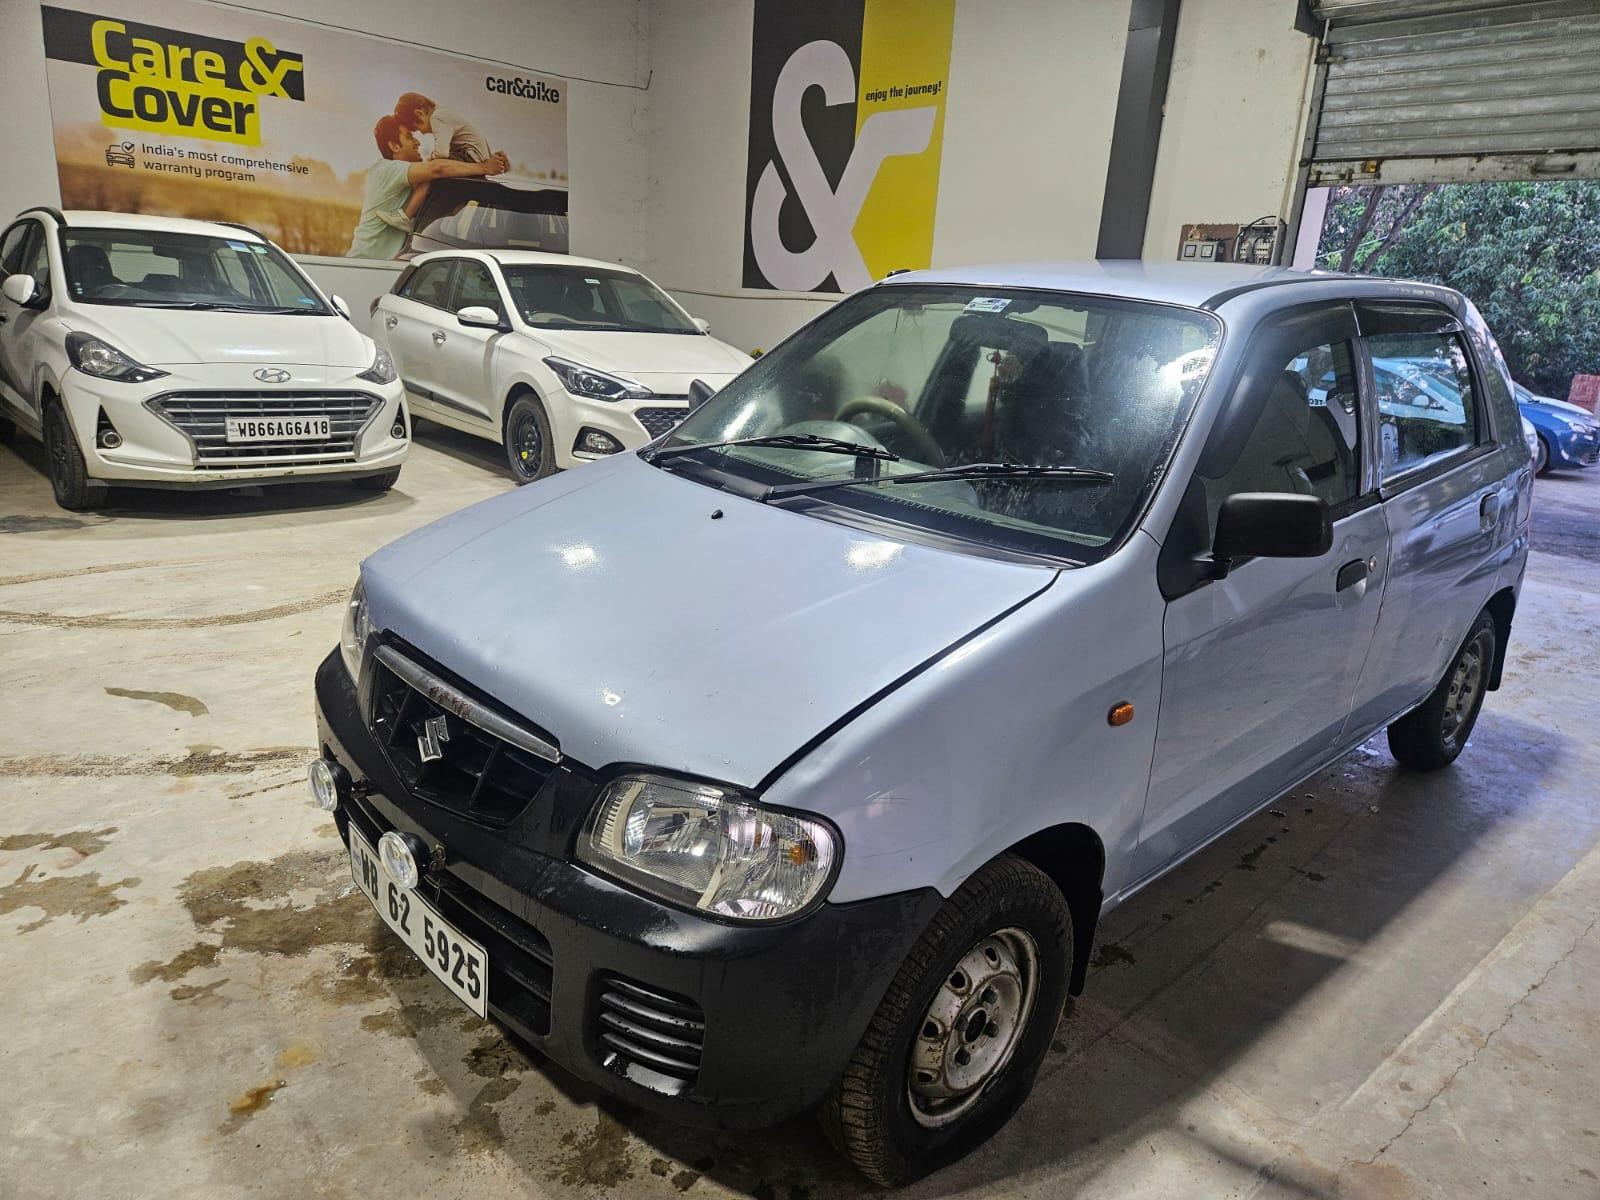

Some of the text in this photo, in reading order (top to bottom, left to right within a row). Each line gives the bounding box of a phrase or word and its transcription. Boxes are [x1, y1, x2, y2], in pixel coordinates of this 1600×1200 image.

[91, 19, 303, 99] Care &
[97, 69, 255, 135] Cover
[486, 77, 559, 103] car&bike
[865, 81, 942, 102] enjoy the journey!
[142, 143, 309, 175] India's most comprehensive
[143, 160, 256, 182] warranty program
[238, 421, 328, 437] WB66AG6418
[361, 848, 379, 900] WB
[388, 881, 411, 936] 62
[424, 914, 481, 999] 5925
